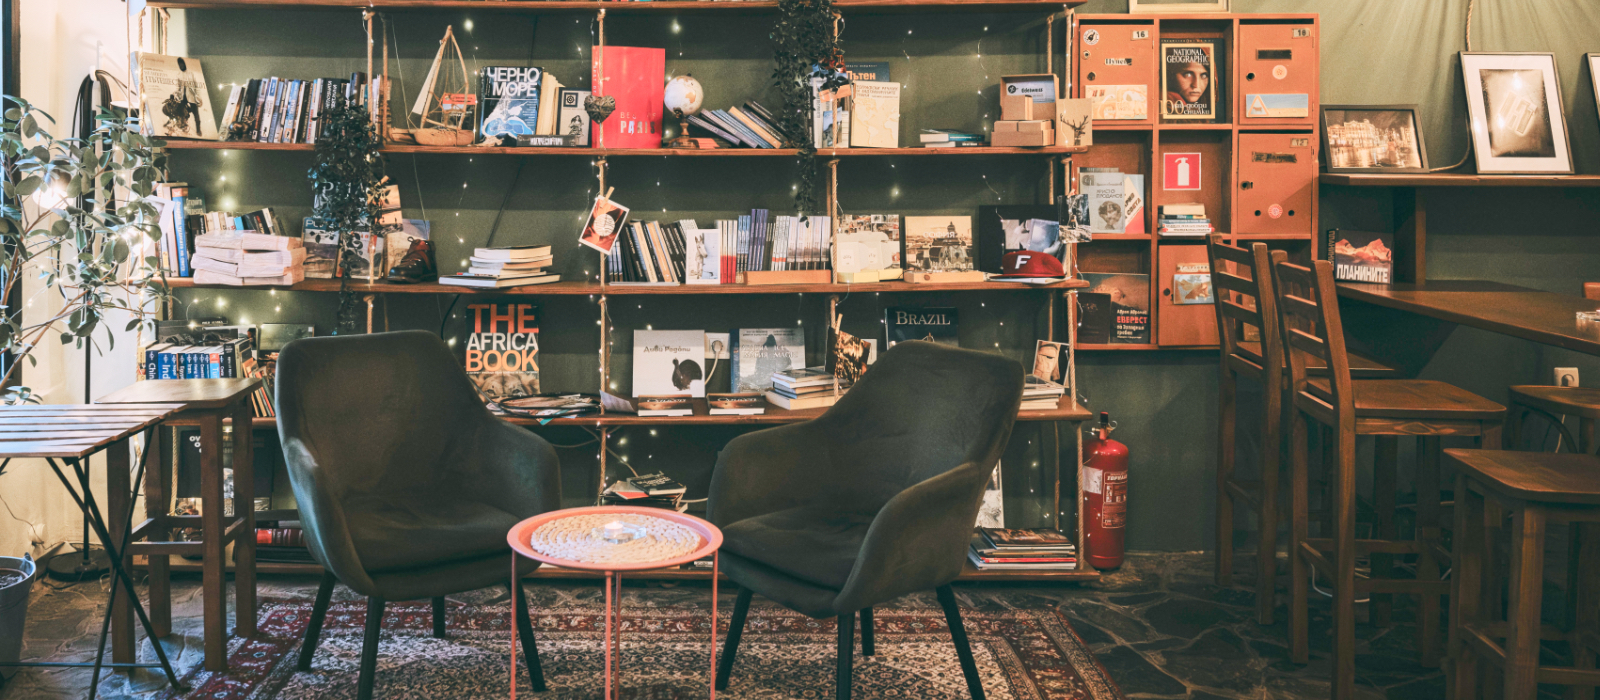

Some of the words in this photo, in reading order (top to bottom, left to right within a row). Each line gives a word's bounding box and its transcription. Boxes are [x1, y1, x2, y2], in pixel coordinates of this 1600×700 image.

[1136, 30, 1146, 38] 16
[1166, 55, 1210, 64] GEOGRAPHIC
[1173, 48, 1204, 56] NATIONAL
[487, 67, 540, 83] ЧЕРНО
[492, 82, 538, 97] МОРЕ
[620, 120, 656, 135] PARIS
[922, 230, 955, 238] СОФИЯ
[1014, 254, 1031, 270] F
[1336, 263, 1389, 283] ПЛАНИНИТЕ
[467, 303, 540, 334] THE
[1116, 315, 1149, 324] ЕВЕРЕСТ
[466, 332, 539, 351] AFRICA
[466, 349, 540, 372] BOOK
